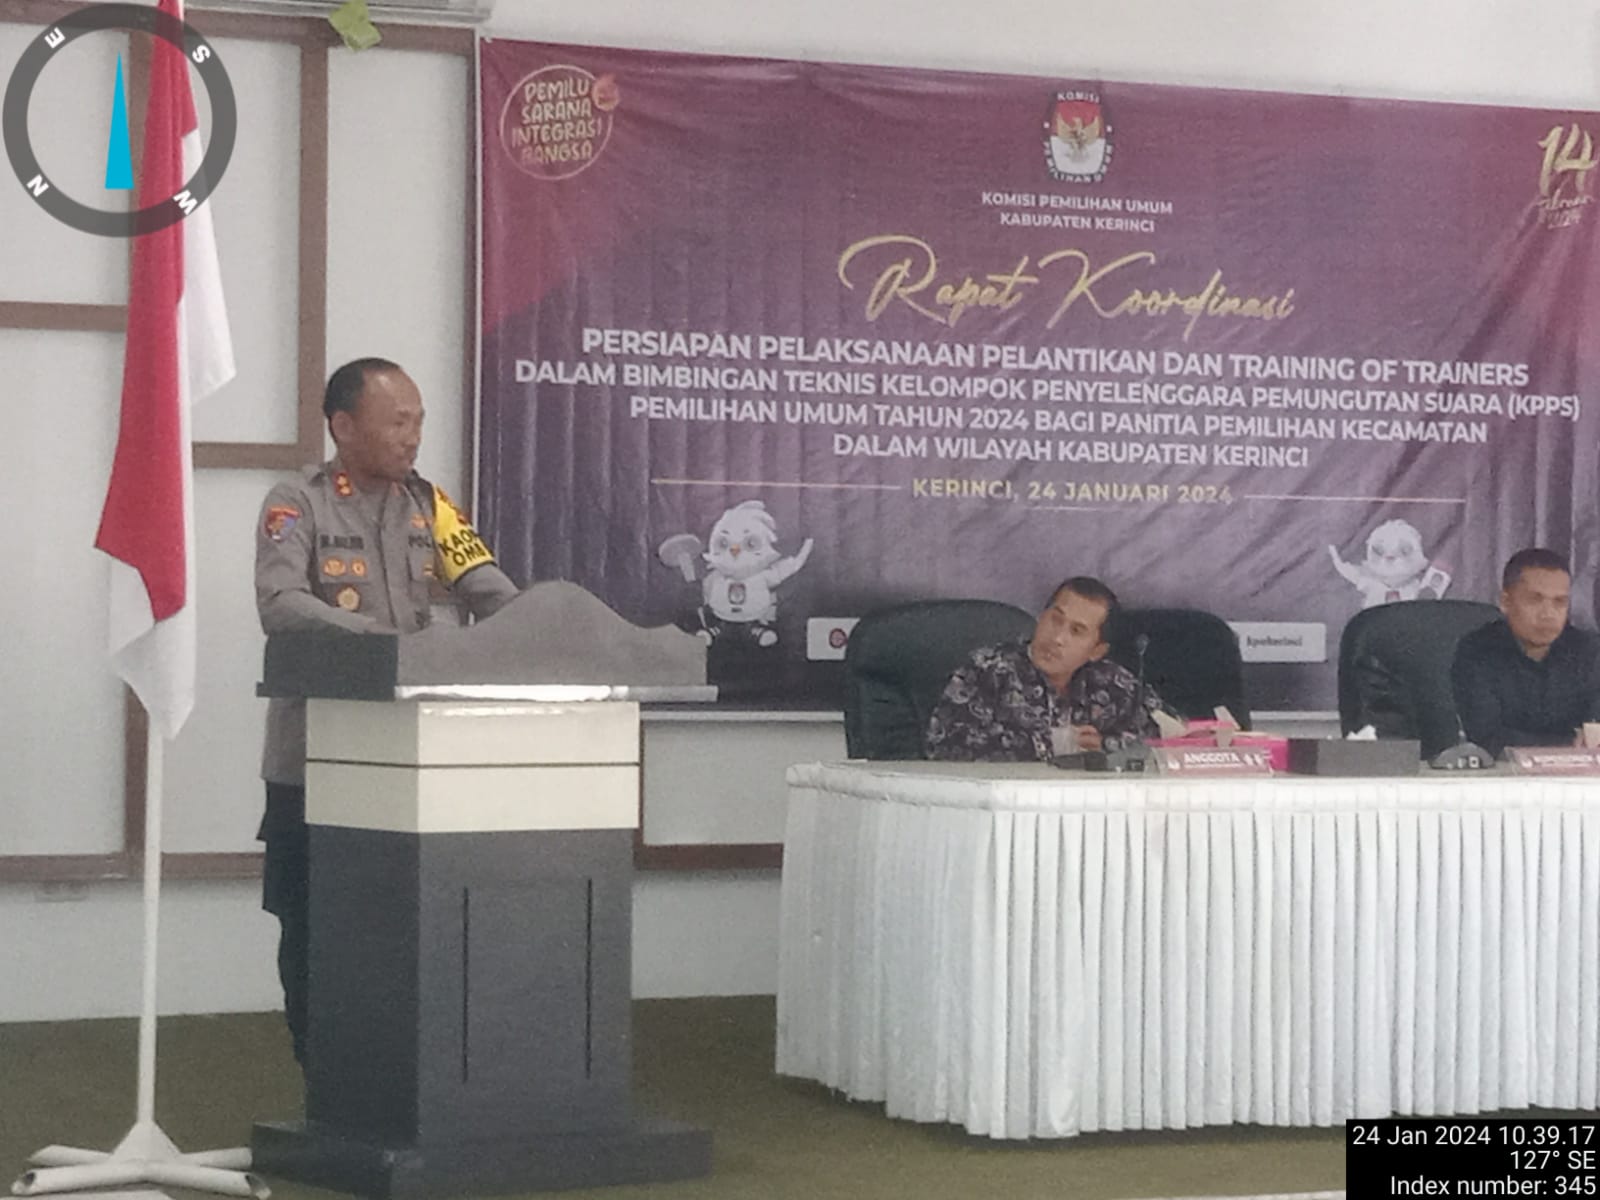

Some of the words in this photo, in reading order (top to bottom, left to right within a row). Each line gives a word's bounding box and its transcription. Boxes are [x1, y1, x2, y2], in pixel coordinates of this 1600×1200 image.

[524, 77, 589, 103] PEMILU
[521, 98, 592, 125] SARANA
[511, 117, 602, 149] INTEGRASI
[1537, 123, 1597, 196] 14
[982, 191, 1037, 207] KOMISI
[1038, 194, 1123, 212] PEMILIHAN
[1125, 200, 1173, 214] UMUM
[1000, 212, 1091, 230] KABUPATEN
[1095, 217, 1155, 233] KERINCI
[838, 235, 1039, 328] Rapat
[1037, 249, 1296, 342] Koordinasi
[582, 327, 751, 358] PERSIAPAN
[758, 335, 975, 367] PELAKSANAAN
[982, 344, 1158, 374] PELANTIKAN
[1163, 351, 1223, 377] DAN
[1229, 354, 1355, 383] TRAINING
[1361, 359, 1397, 383] OF
[1402, 360, 1529, 387] TRAINERS
[515, 358, 616, 387] DALAM
[623, 364, 778, 393] BIMBINGAN
[784, 371, 876, 396] TEKNIS
[882, 375, 1026, 401] KELOMPOK
[1032, 379, 1246, 410] PENYELENGGARA
[1252, 387, 1421, 414] PEMUNGUTAN
[1425, 394, 1502, 416] SUARA
[1508, 394, 1581, 423] (KPPS)
[630, 395, 778, 425] PEMILIHAN
[784, 404, 868, 428] UMUM
[874, 406, 964, 431] TAHUN
[969, 408, 1030, 432] 2024
[1035, 412, 1096, 434] BAGI
[1101, 414, 1199, 438] PANITIA
[1204, 417, 1336, 441] PEMILIHAN
[1341, 420, 1488, 444] KECAMATAN
[833, 433, 928, 459] DALAM
[934, 436, 1052, 463] WILAYAH
[1057, 440, 1208, 467] KABUPATEN
[1213, 445, 1309, 469] KERINCI
[912, 478, 1020, 503] KERINCI,
[1027, 482, 1057, 500] 24
[1064, 483, 1169, 503] JANUARI
[1176, 485, 1234, 506] 2024
[438, 529, 480, 557] KAO
